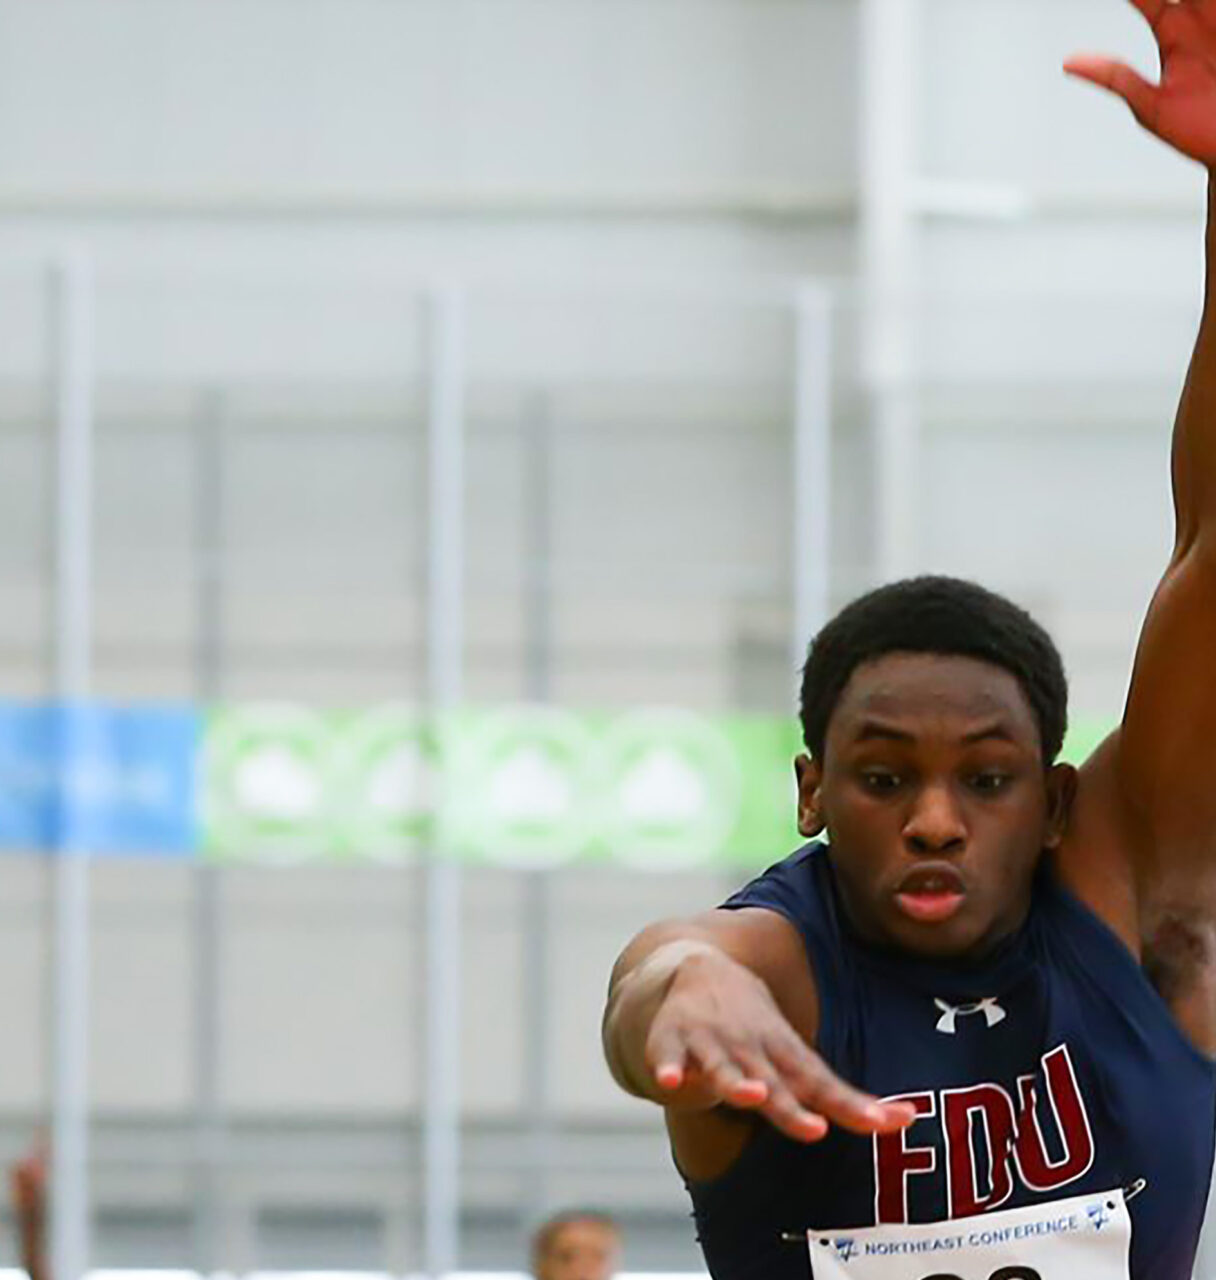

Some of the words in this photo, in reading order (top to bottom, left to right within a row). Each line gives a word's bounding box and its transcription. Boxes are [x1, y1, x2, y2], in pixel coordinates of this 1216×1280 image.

[874, 1043, 1094, 1226] FDU
[865, 1237, 963, 1255] NORTHEAST
[968, 1216, 1077, 1247] CONFERENCE
